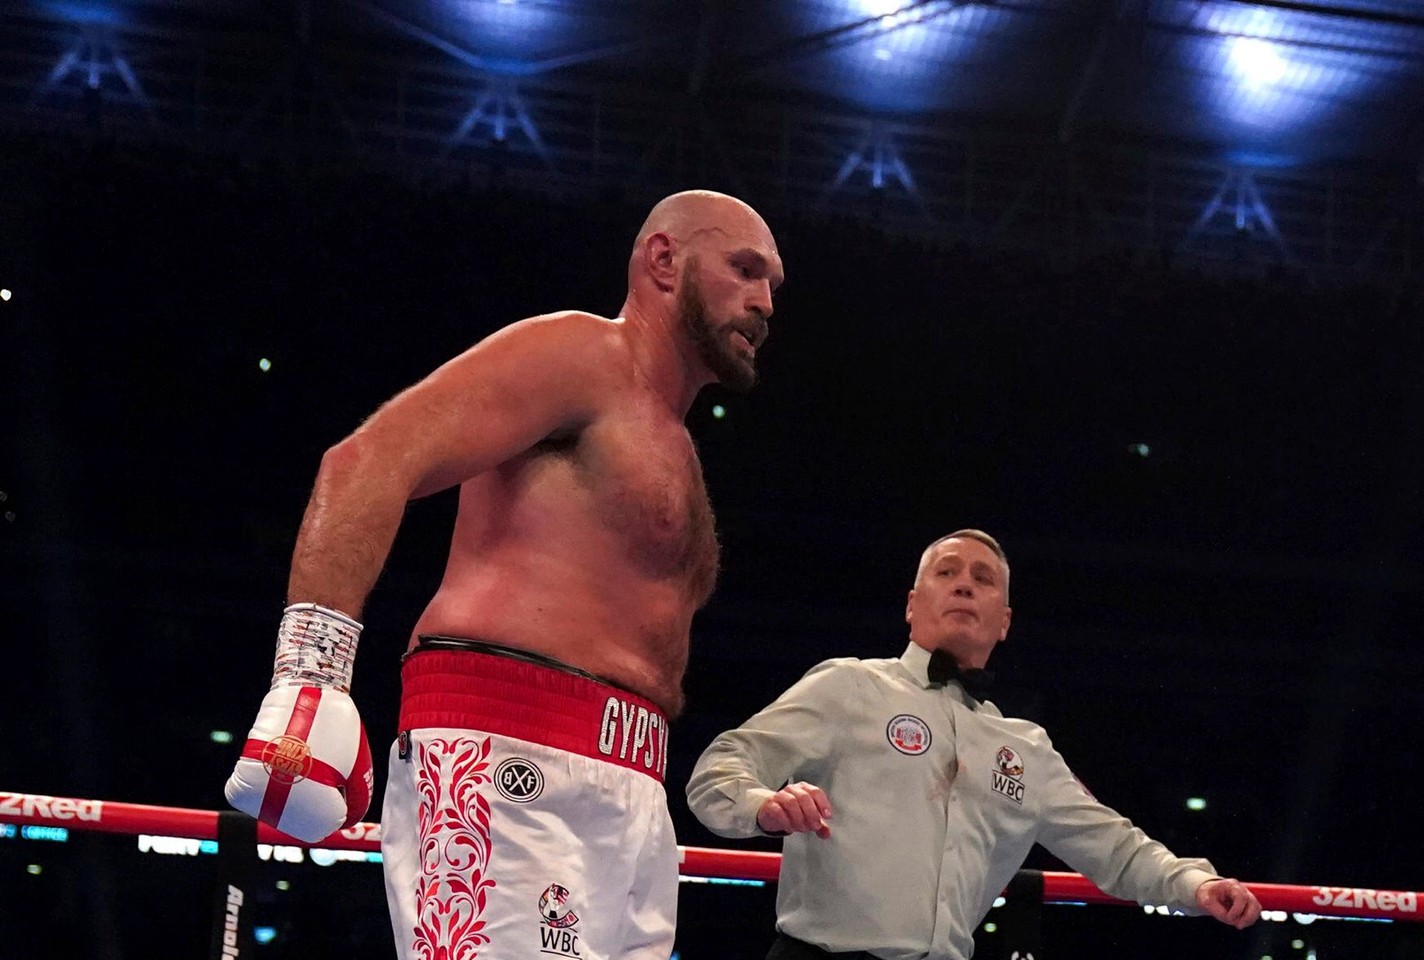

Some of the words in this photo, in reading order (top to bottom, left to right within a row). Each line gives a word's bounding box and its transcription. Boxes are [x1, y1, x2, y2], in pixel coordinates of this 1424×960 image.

[599, 696, 668, 778] GYPSY
[993, 772, 1024, 802] WBC
[0, 791, 103, 822] 2Red
[1312, 886, 1417, 914] 32Red
[540, 926, 581, 956] WBC
